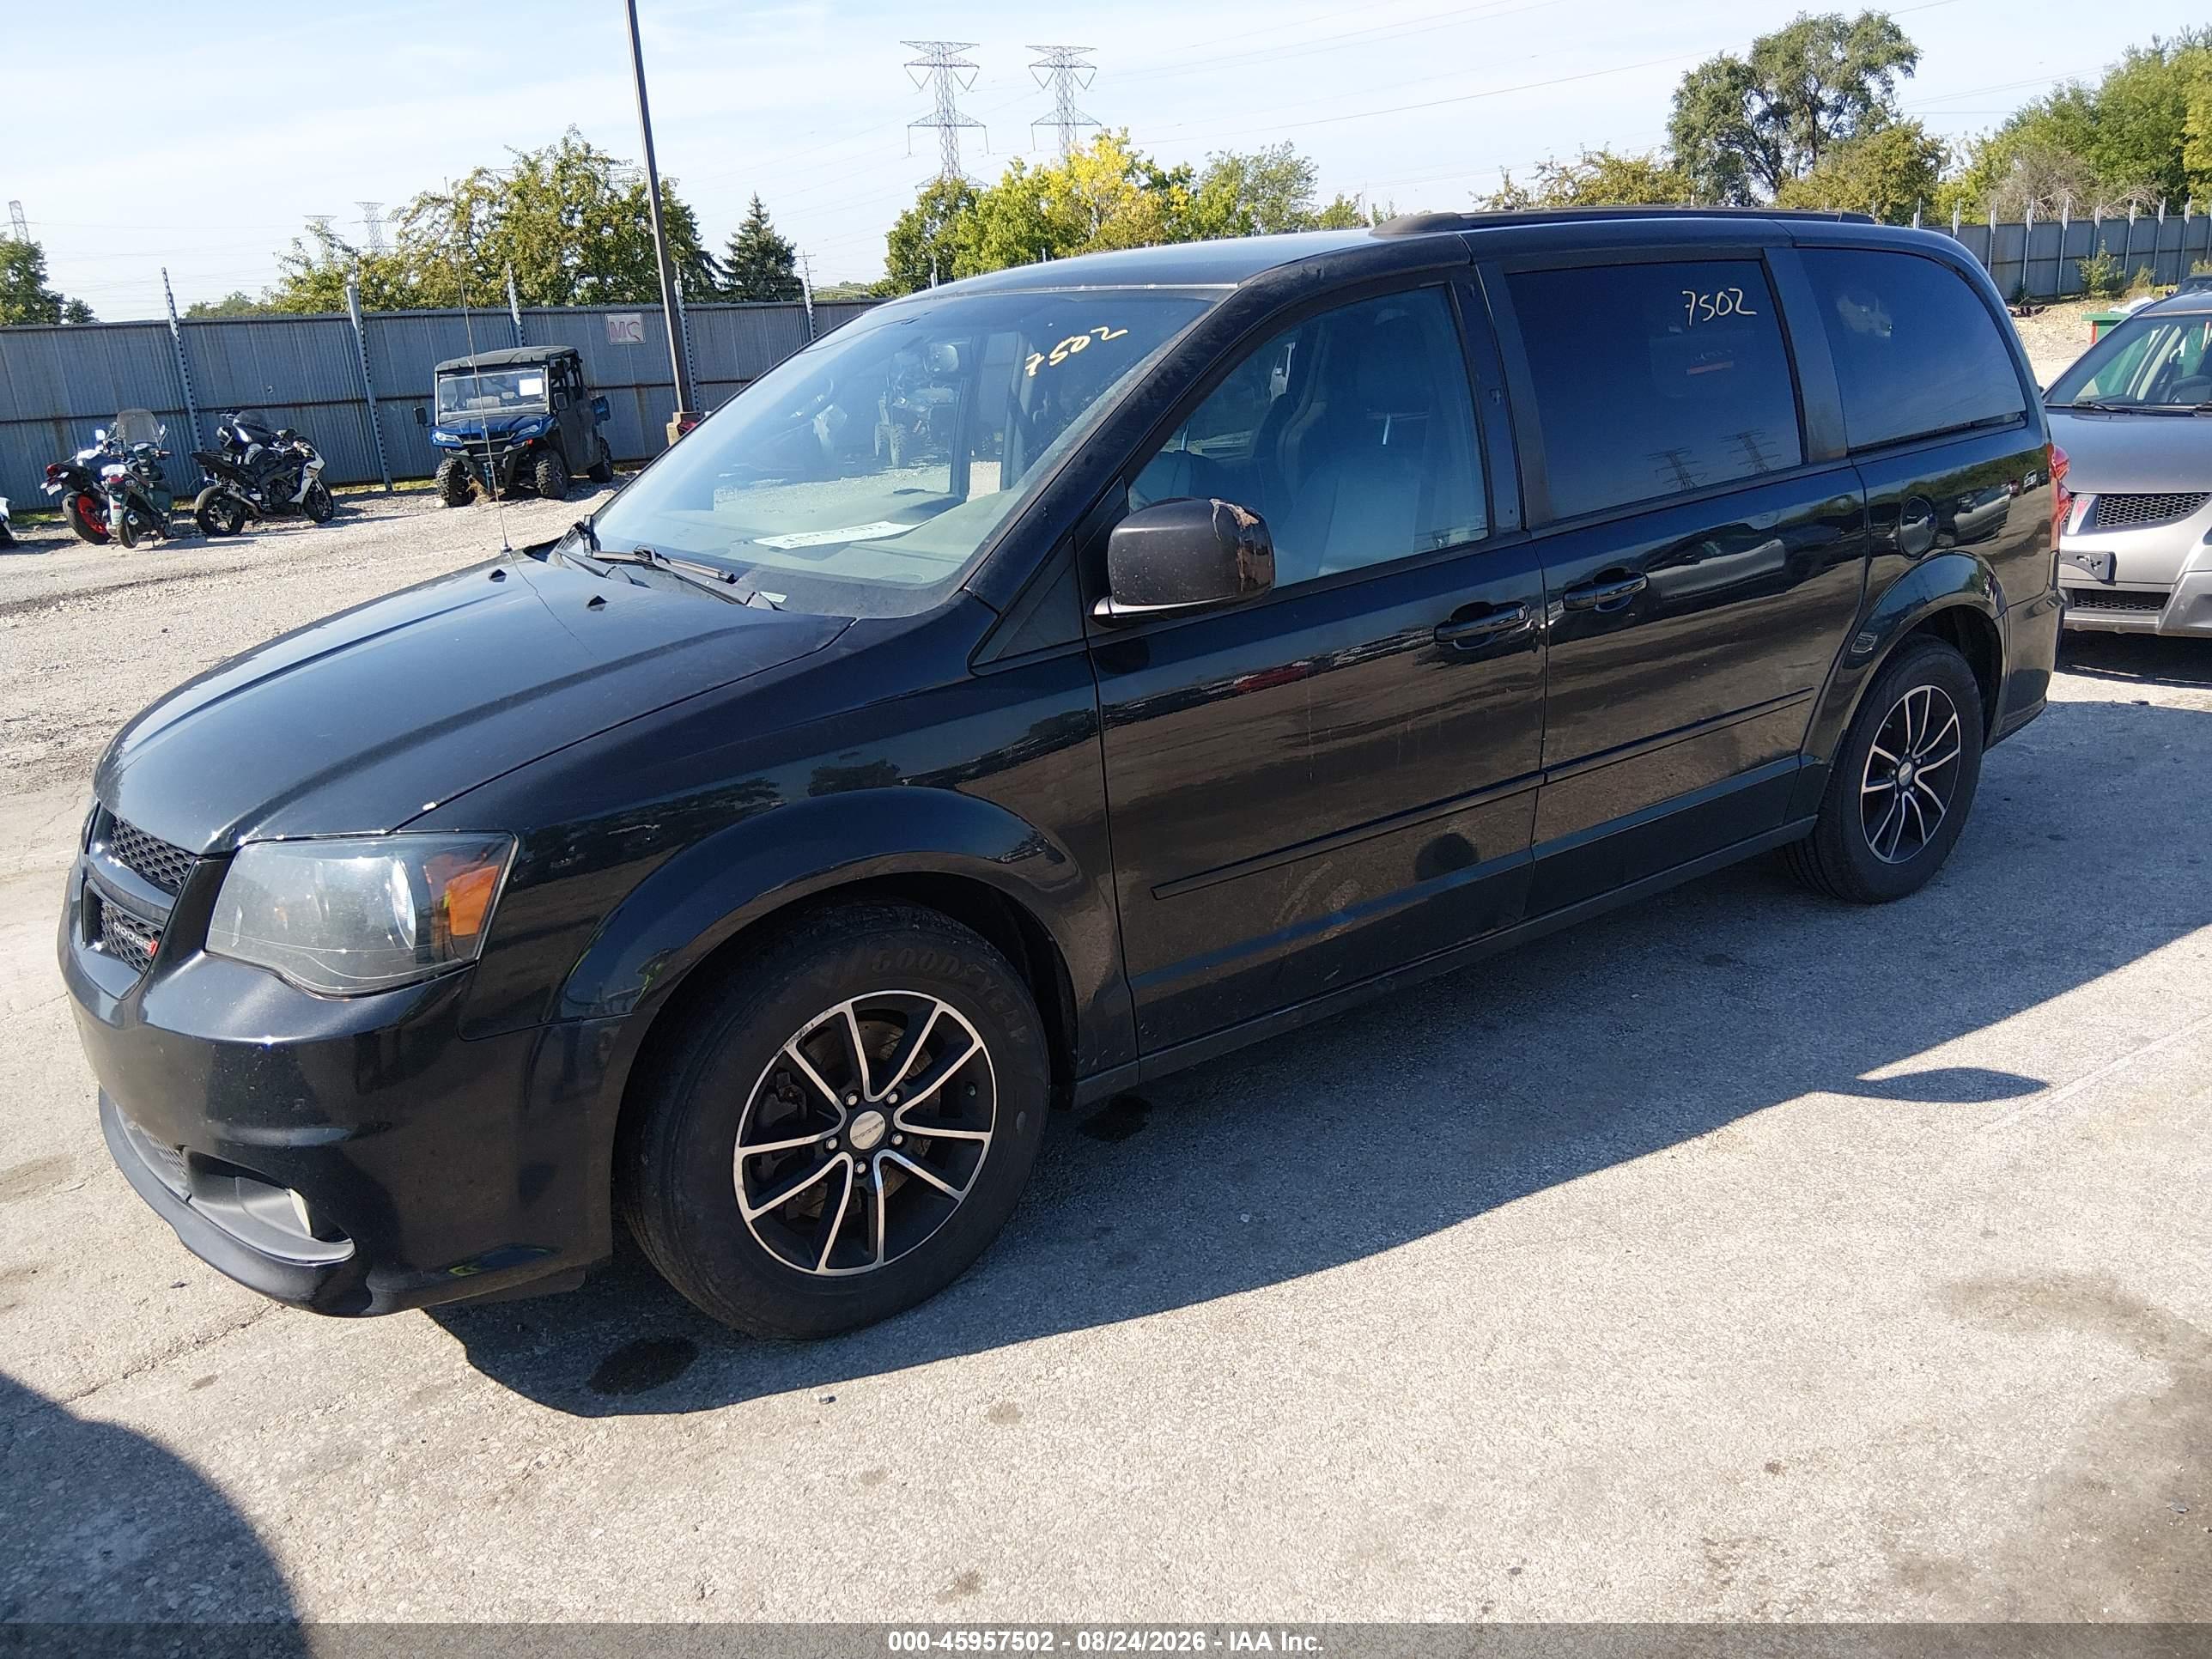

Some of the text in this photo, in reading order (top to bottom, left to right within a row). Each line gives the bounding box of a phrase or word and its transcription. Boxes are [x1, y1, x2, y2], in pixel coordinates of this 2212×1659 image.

[1681, 288, 1758, 327] 7502
[1024, 325, 1129, 377] 7502
[113, 921, 153, 951] DODGE
